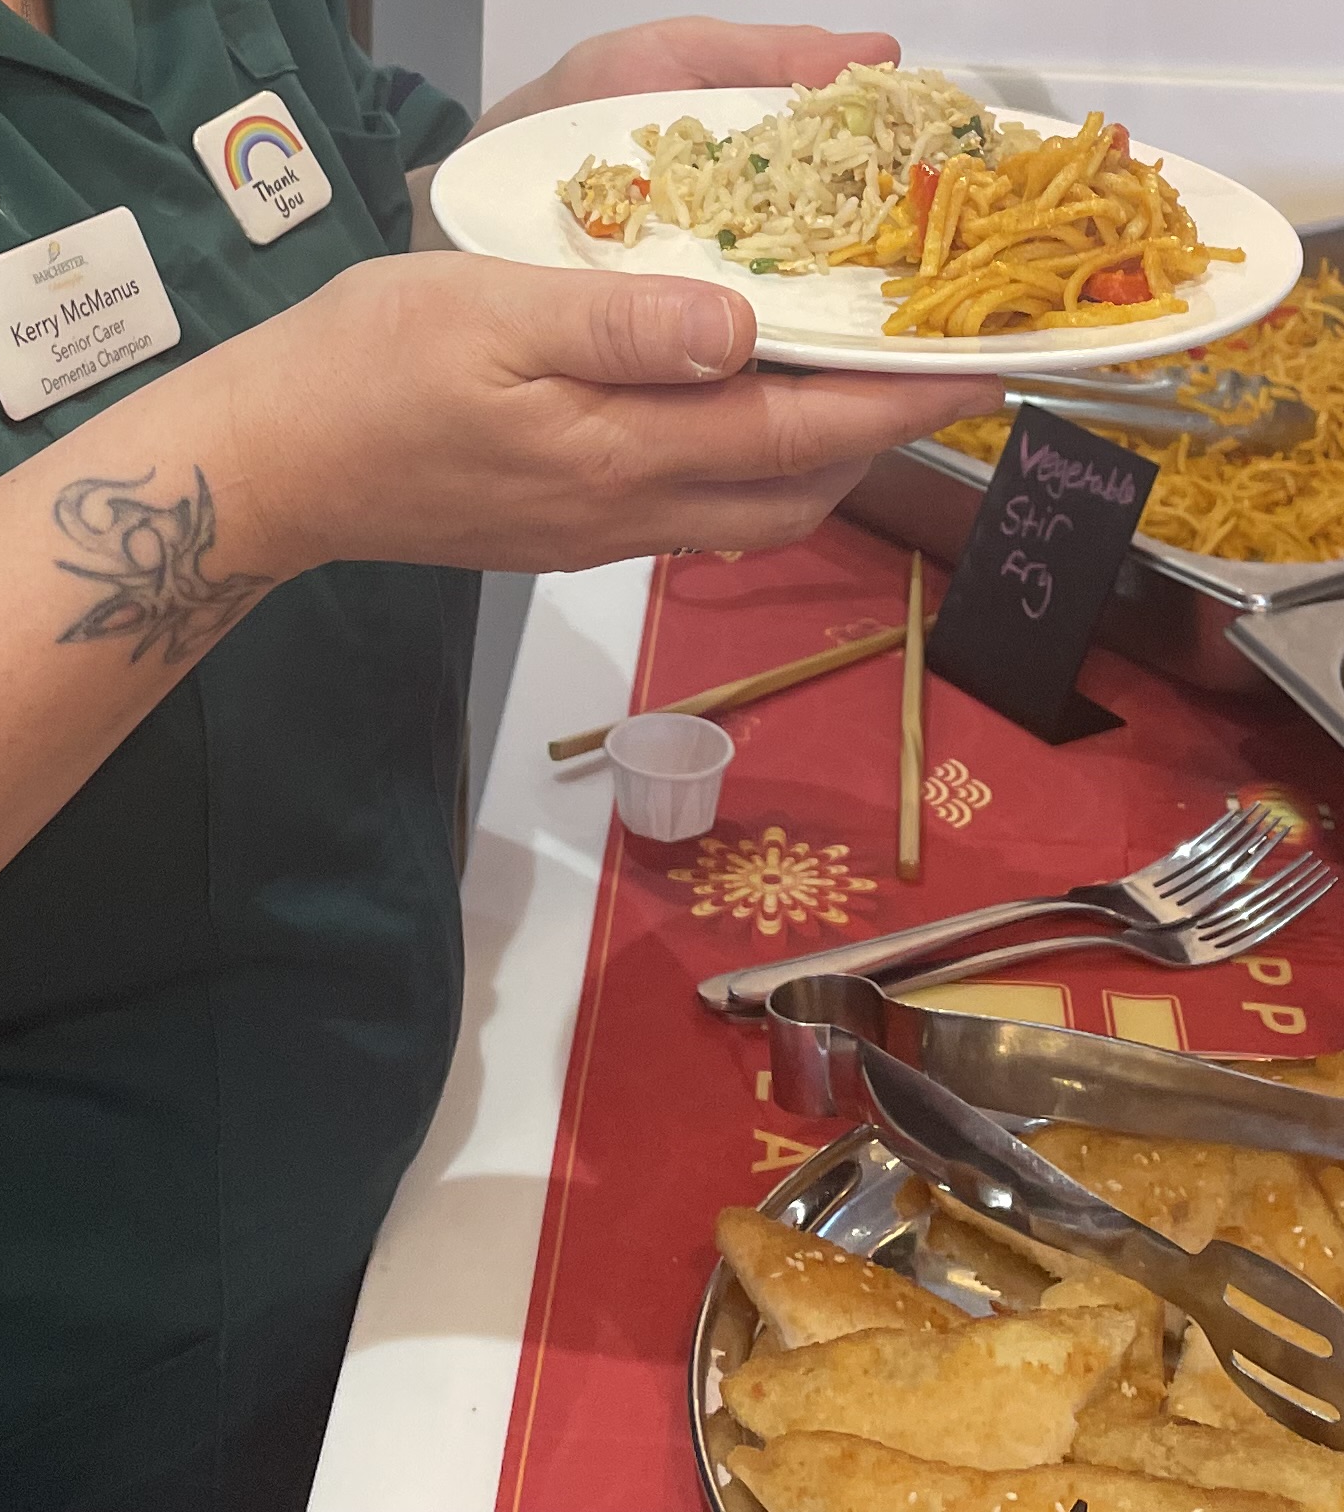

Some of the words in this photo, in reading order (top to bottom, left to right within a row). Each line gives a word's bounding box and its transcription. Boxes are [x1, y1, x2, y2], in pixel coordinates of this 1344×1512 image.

[252, 165, 300, 203] Thank
[274, 191, 305, 219] You
[32, 254, 89, 285] BARCHESTER
[9, 314, 60, 348] Kerry
[60, 279, 140, 326] McManus
[51, 335, 92, 363] Senior
[92, 319, 126, 343] Carer
[41, 360, 97, 395] Dementia
[97, 334, 153, 368] Champion
[1000, 495, 1074, 541] Stir
